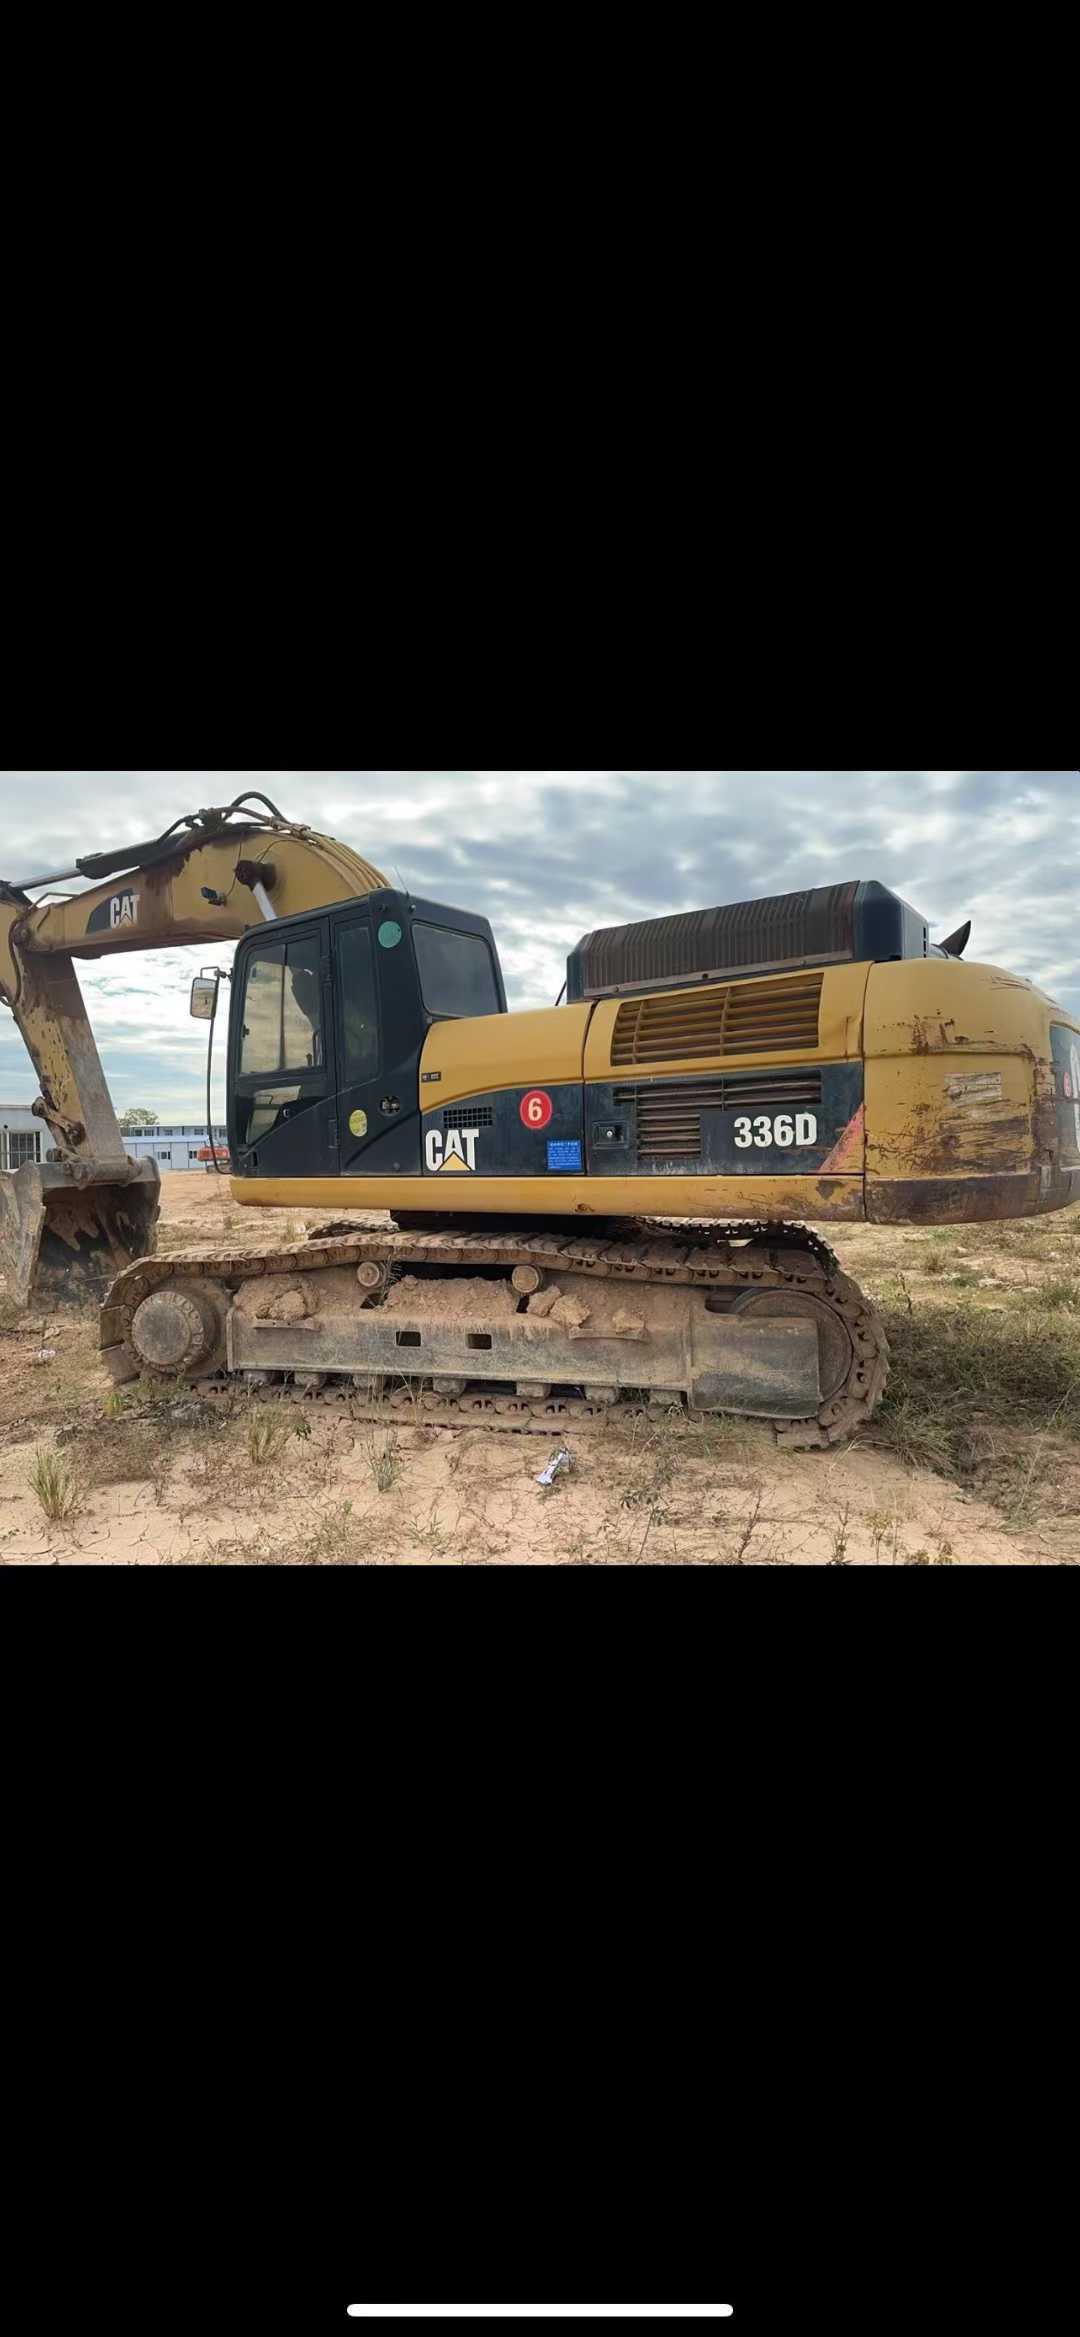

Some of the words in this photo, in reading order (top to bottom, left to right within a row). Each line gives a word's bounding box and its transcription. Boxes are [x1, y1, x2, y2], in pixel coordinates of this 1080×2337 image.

[110, 895, 140, 928] CAT
[528, 1097, 542, 1121] 6
[734, 1112, 817, 1148] 336D
[425, 1129, 479, 1171] CAT
